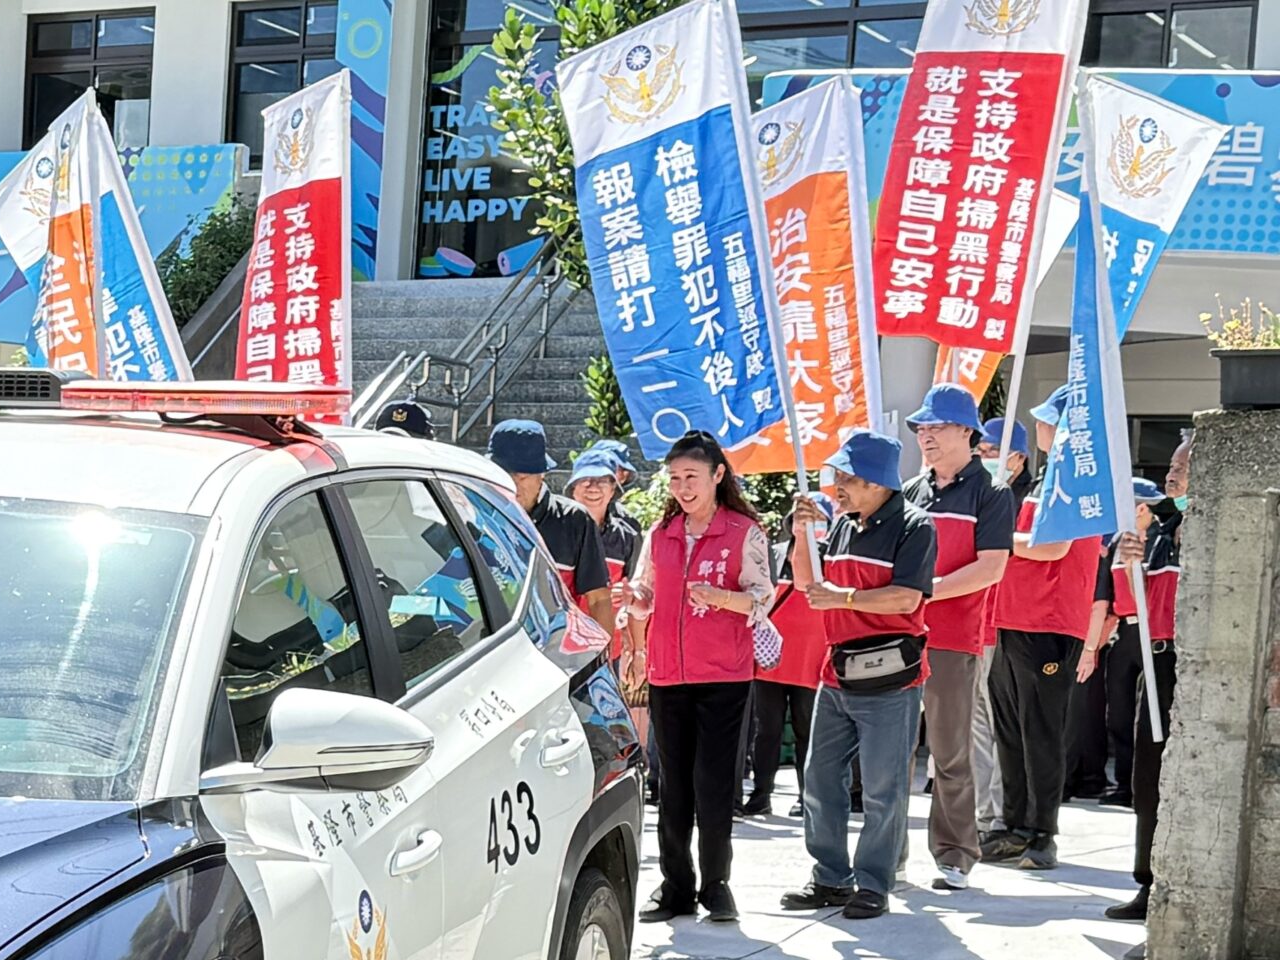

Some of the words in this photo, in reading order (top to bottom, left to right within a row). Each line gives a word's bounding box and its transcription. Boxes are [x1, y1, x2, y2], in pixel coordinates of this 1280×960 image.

[422, 197, 529, 224] HAPPY
[424, 166, 492, 192] LIVE
[426, 134, 506, 160] EASY
[883, 65, 967, 319] 就是保障自己安寧
[936, 67, 1022, 329] 支持政府掃黑行動
[654, 138, 744, 437] 檢舉罪犯不後人
[990, 177, 1037, 305] 基隆市警察局
[770, 207, 829, 447] 治安靠大家
[487, 781, 541, 874] 433
